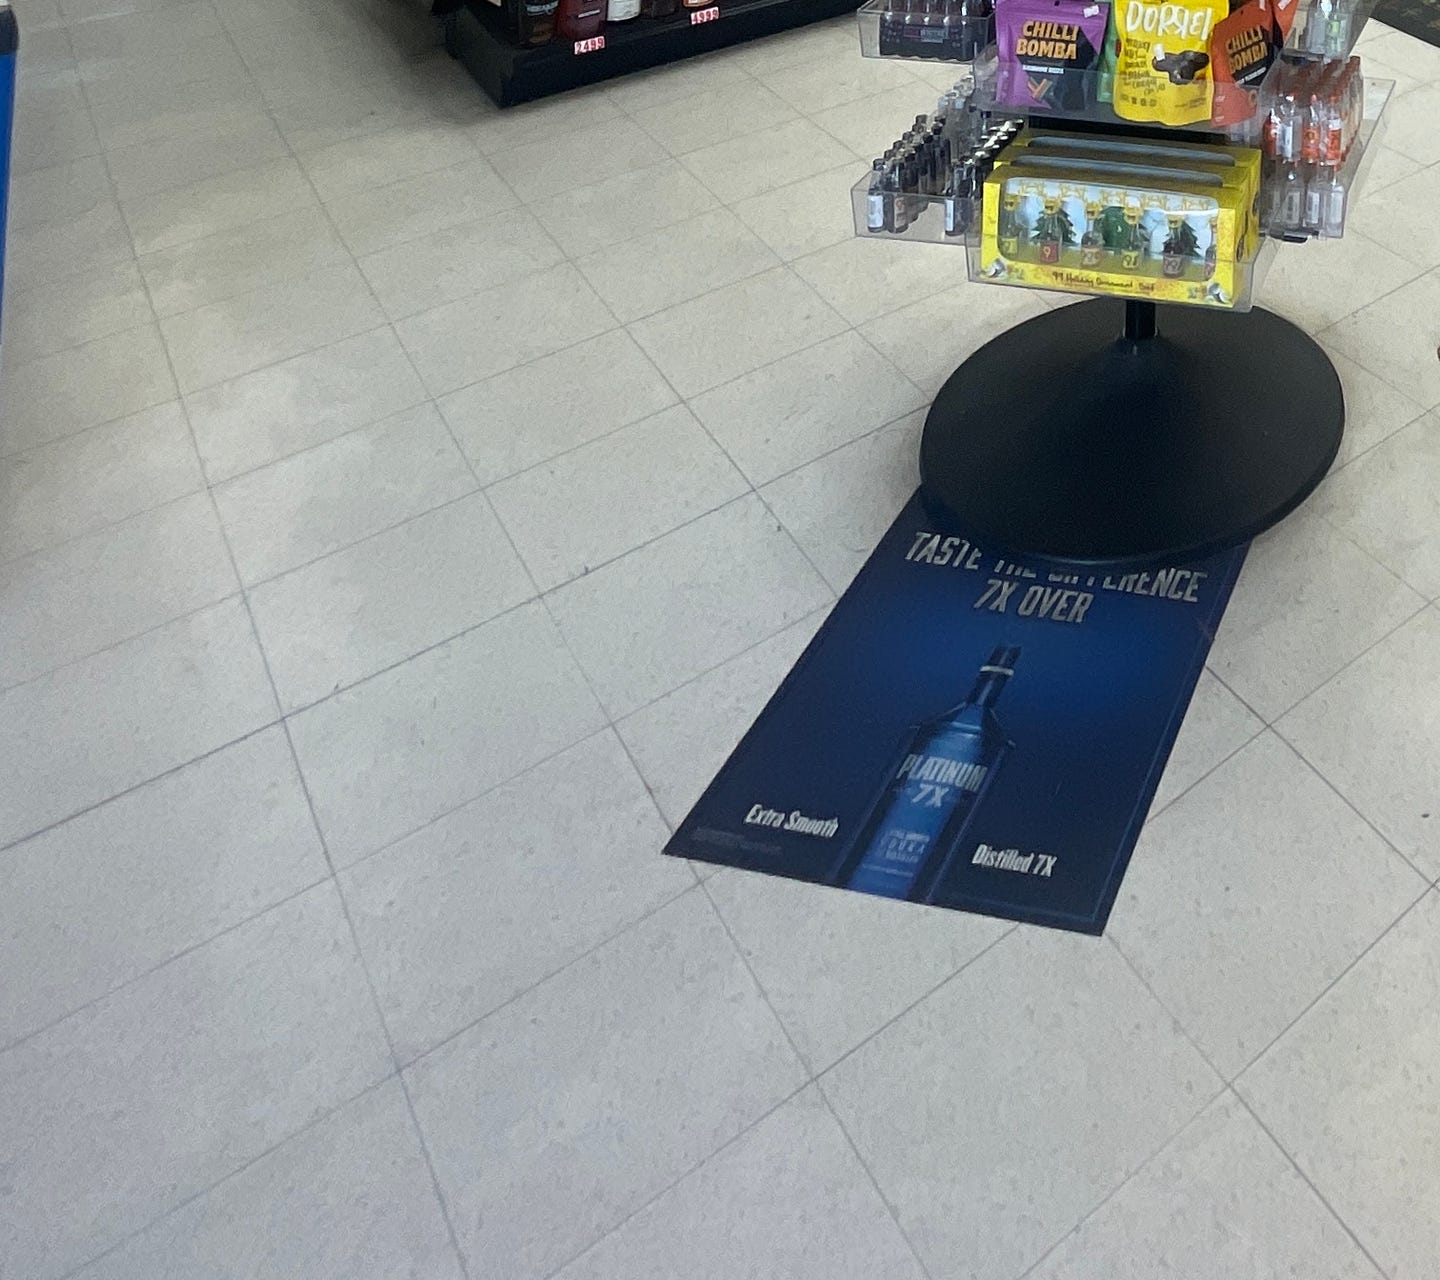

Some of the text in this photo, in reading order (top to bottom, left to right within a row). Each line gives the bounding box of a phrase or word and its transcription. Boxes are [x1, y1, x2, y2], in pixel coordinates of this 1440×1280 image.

[1022, 20, 1080, 41] CHILLI
[1225, 24, 1263, 55] CHILLI
[1016, 39, 1078, 60] BOMBA
[1228, 41, 1268, 73] BOMBA
[974, 578, 1094, 623] 7X OVER
[896, 753, 988, 791] PLATINUM
[911, 783, 951, 809] 7X
[744, 804, 840, 839] Extra Smooth
[971, 843, 1058, 877] Distilled 7X
